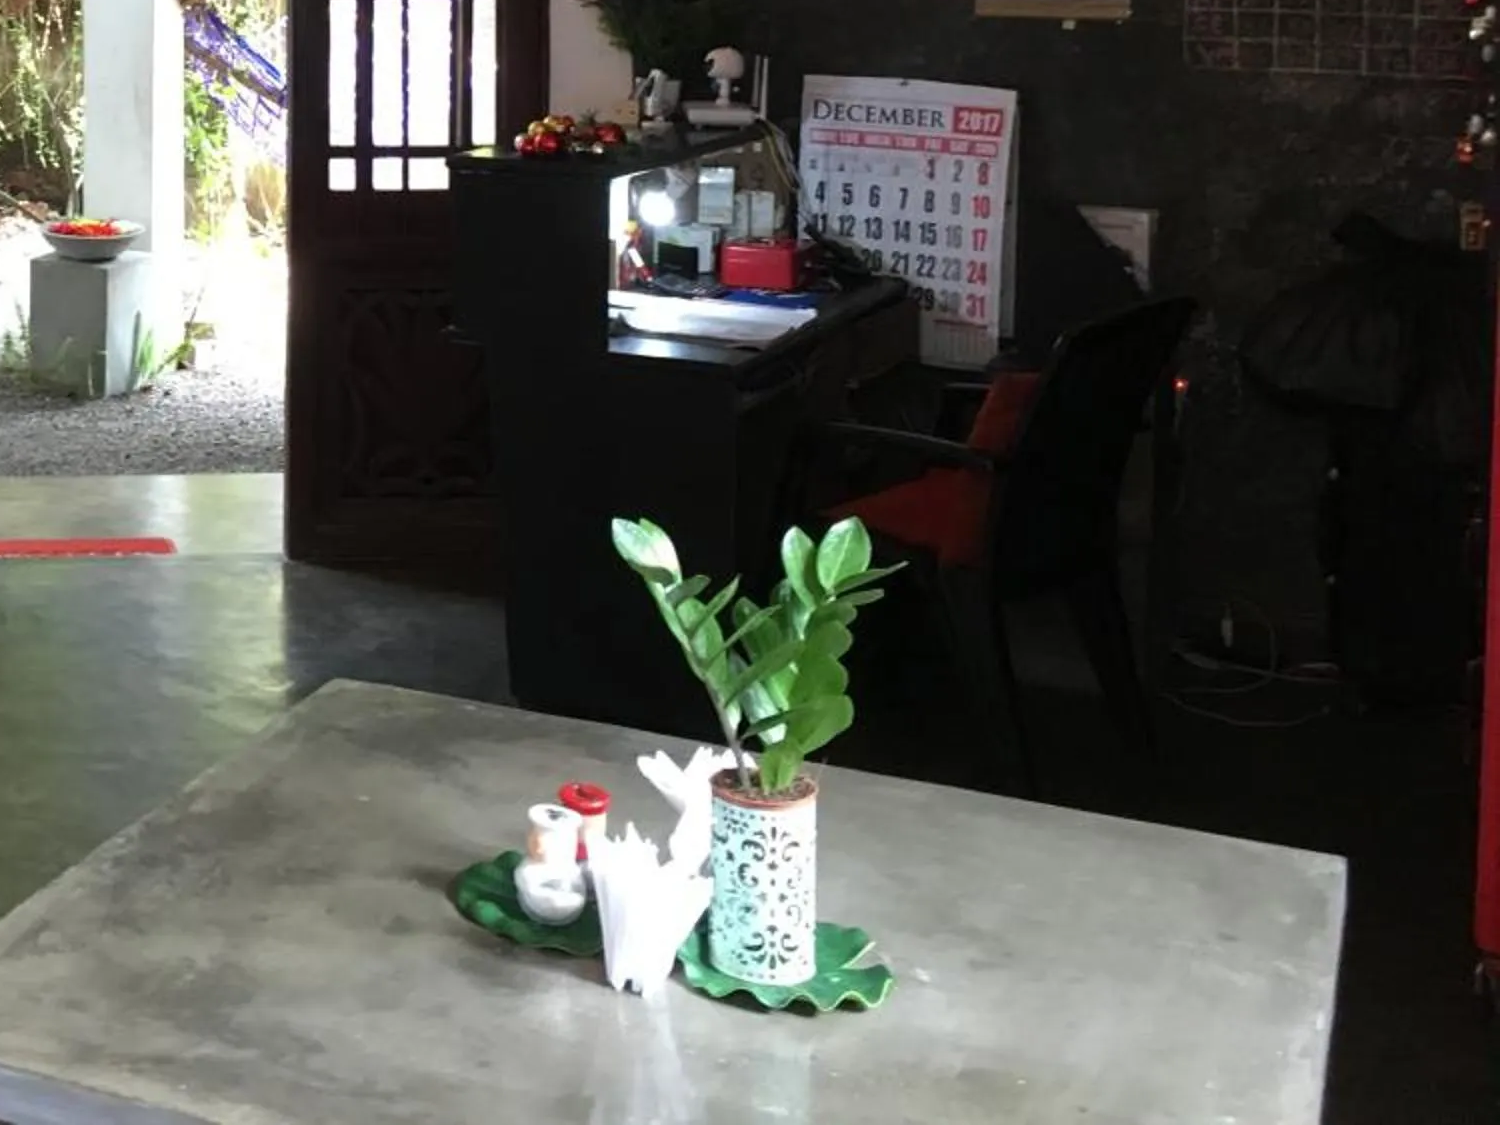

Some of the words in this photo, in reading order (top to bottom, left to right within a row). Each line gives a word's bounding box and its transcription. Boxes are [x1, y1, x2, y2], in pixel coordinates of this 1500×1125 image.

[812, 98, 946, 128] DECEMBER
[957, 109, 1001, 134] 2017
[926, 158, 936, 179] 1
[952, 159, 965, 183] 2
[814, 180, 826, 204] 4
[841, 182, 853, 206] 5
[868, 185, 882, 208] 6
[899, 187, 909, 211] 7
[923, 189, 936, 213] 8
[950, 191, 962, 216] 9
[972, 195, 992, 219] 10
[838, 214, 857, 237] 12
[864, 216, 883, 240] 13
[893, 219, 912, 243] 14
[919, 222, 937, 246] 15
[946, 225, 963, 249] 16
[971, 228, 988, 253] 17
[891, 250, 911, 276] 21
[915, 253, 937, 279] 22
[942, 257, 963, 282] 23
[966, 260, 988, 286] 24
[966, 293, 986, 318] 31
